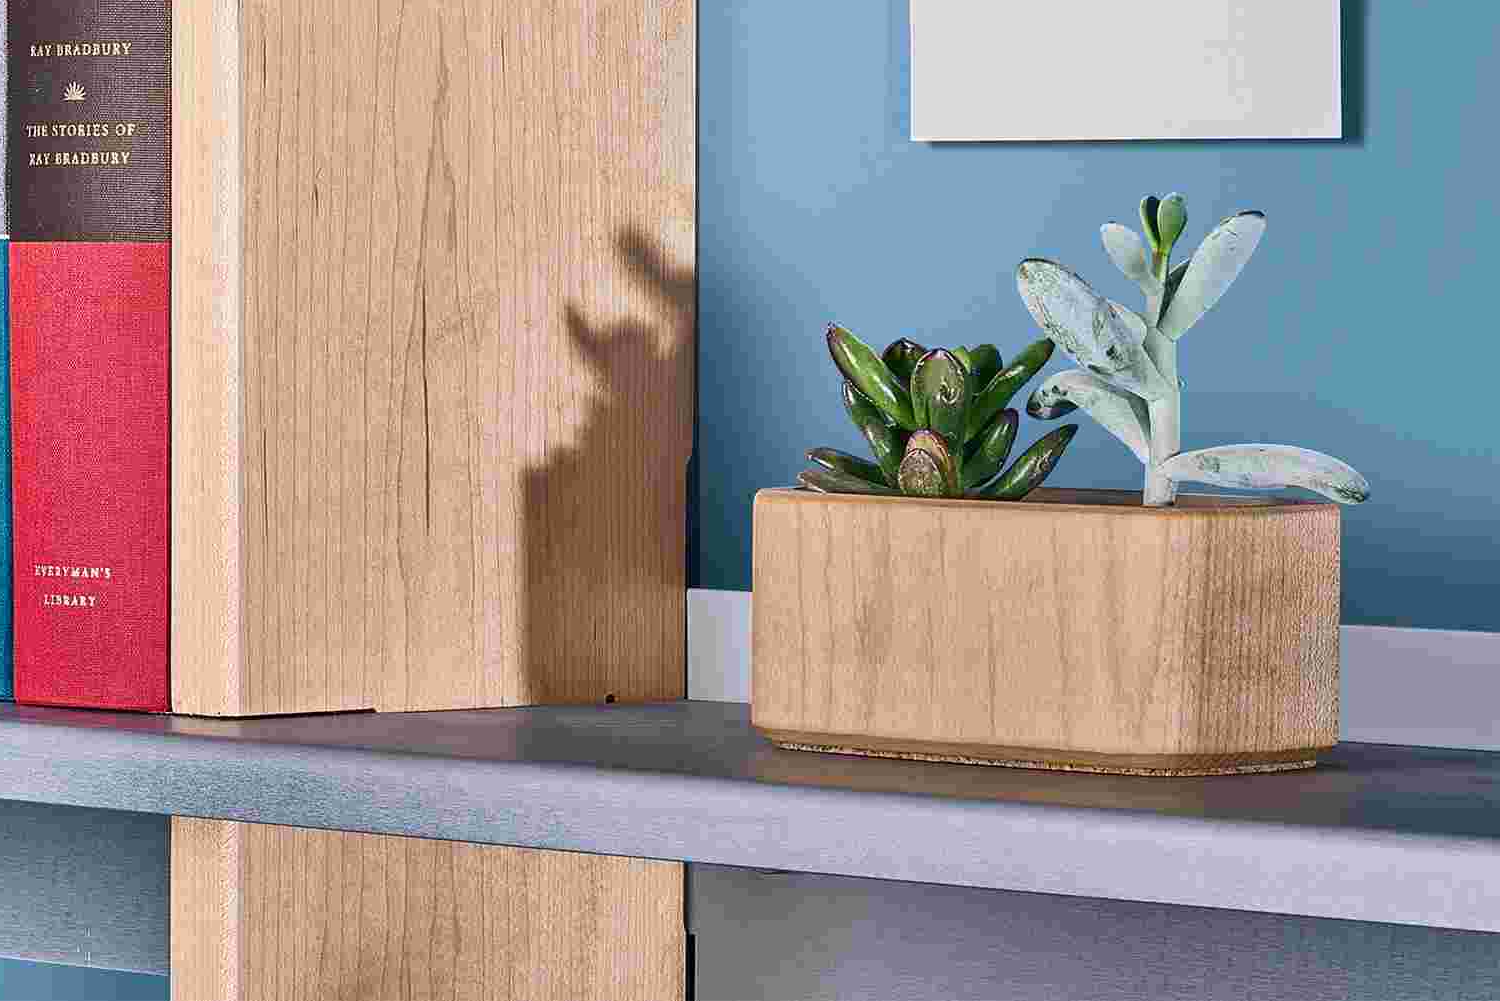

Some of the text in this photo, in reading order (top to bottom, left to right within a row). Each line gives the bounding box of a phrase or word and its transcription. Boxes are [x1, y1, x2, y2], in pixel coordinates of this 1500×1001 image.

[29, 41, 133, 58] RAY BRADBURY
[26, 123, 137, 138] THE STORIES OF
[28, 151, 131, 167] RAY BRADBURY
[43, 593, 97, 608] LIBRARY
